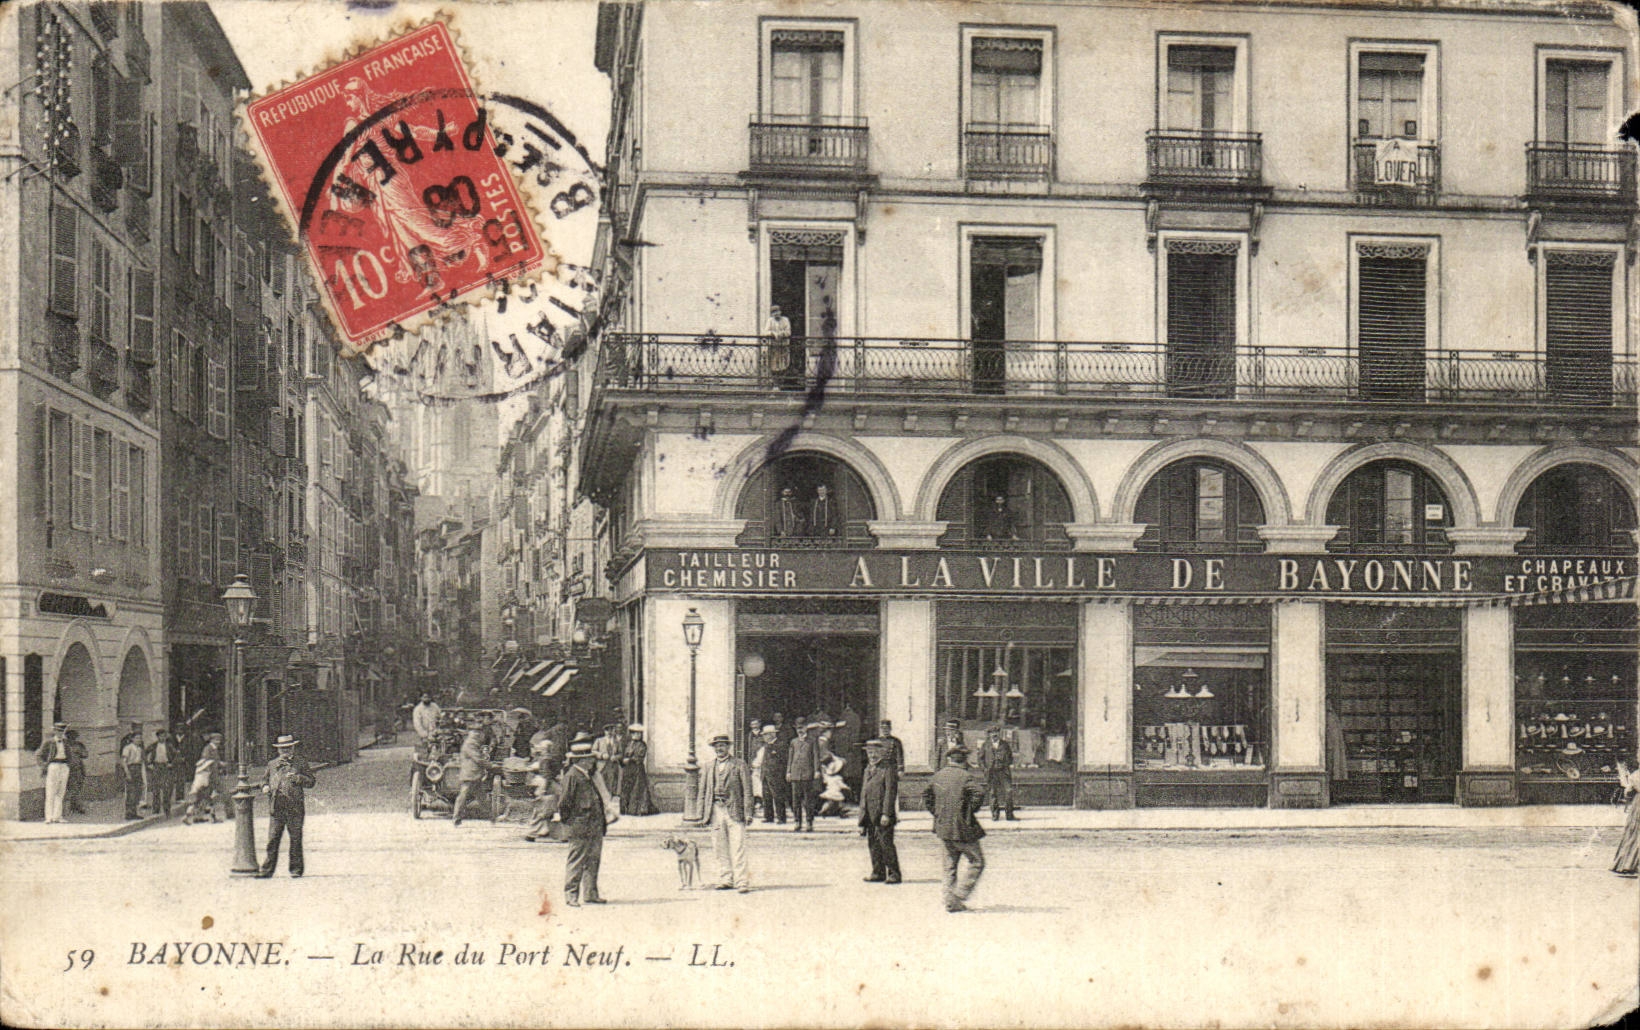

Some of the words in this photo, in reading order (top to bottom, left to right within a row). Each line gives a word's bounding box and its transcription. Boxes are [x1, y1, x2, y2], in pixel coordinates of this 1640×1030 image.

[363, 34, 443, 81] FRANÇAISE
[1393, 140, 1401, 150] A
[1376, 160, 1417, 184] LOUER
[480, 172, 525, 254] POSTES
[678, 552, 780, 568] TAILLEUR
[1522, 559, 1625, 575] CHAPEAUX
[663, 569, 797, 588] CHEMISIER
[850, 556, 875, 588] A
[900, 556, 955, 588] LA
[976, 557, 1117, 589] VILLE
[1170, 559, 1225, 590] DE
[1278, 559, 1473, 592] BAYONNE
[1504, 575, 1528, 593] ET
